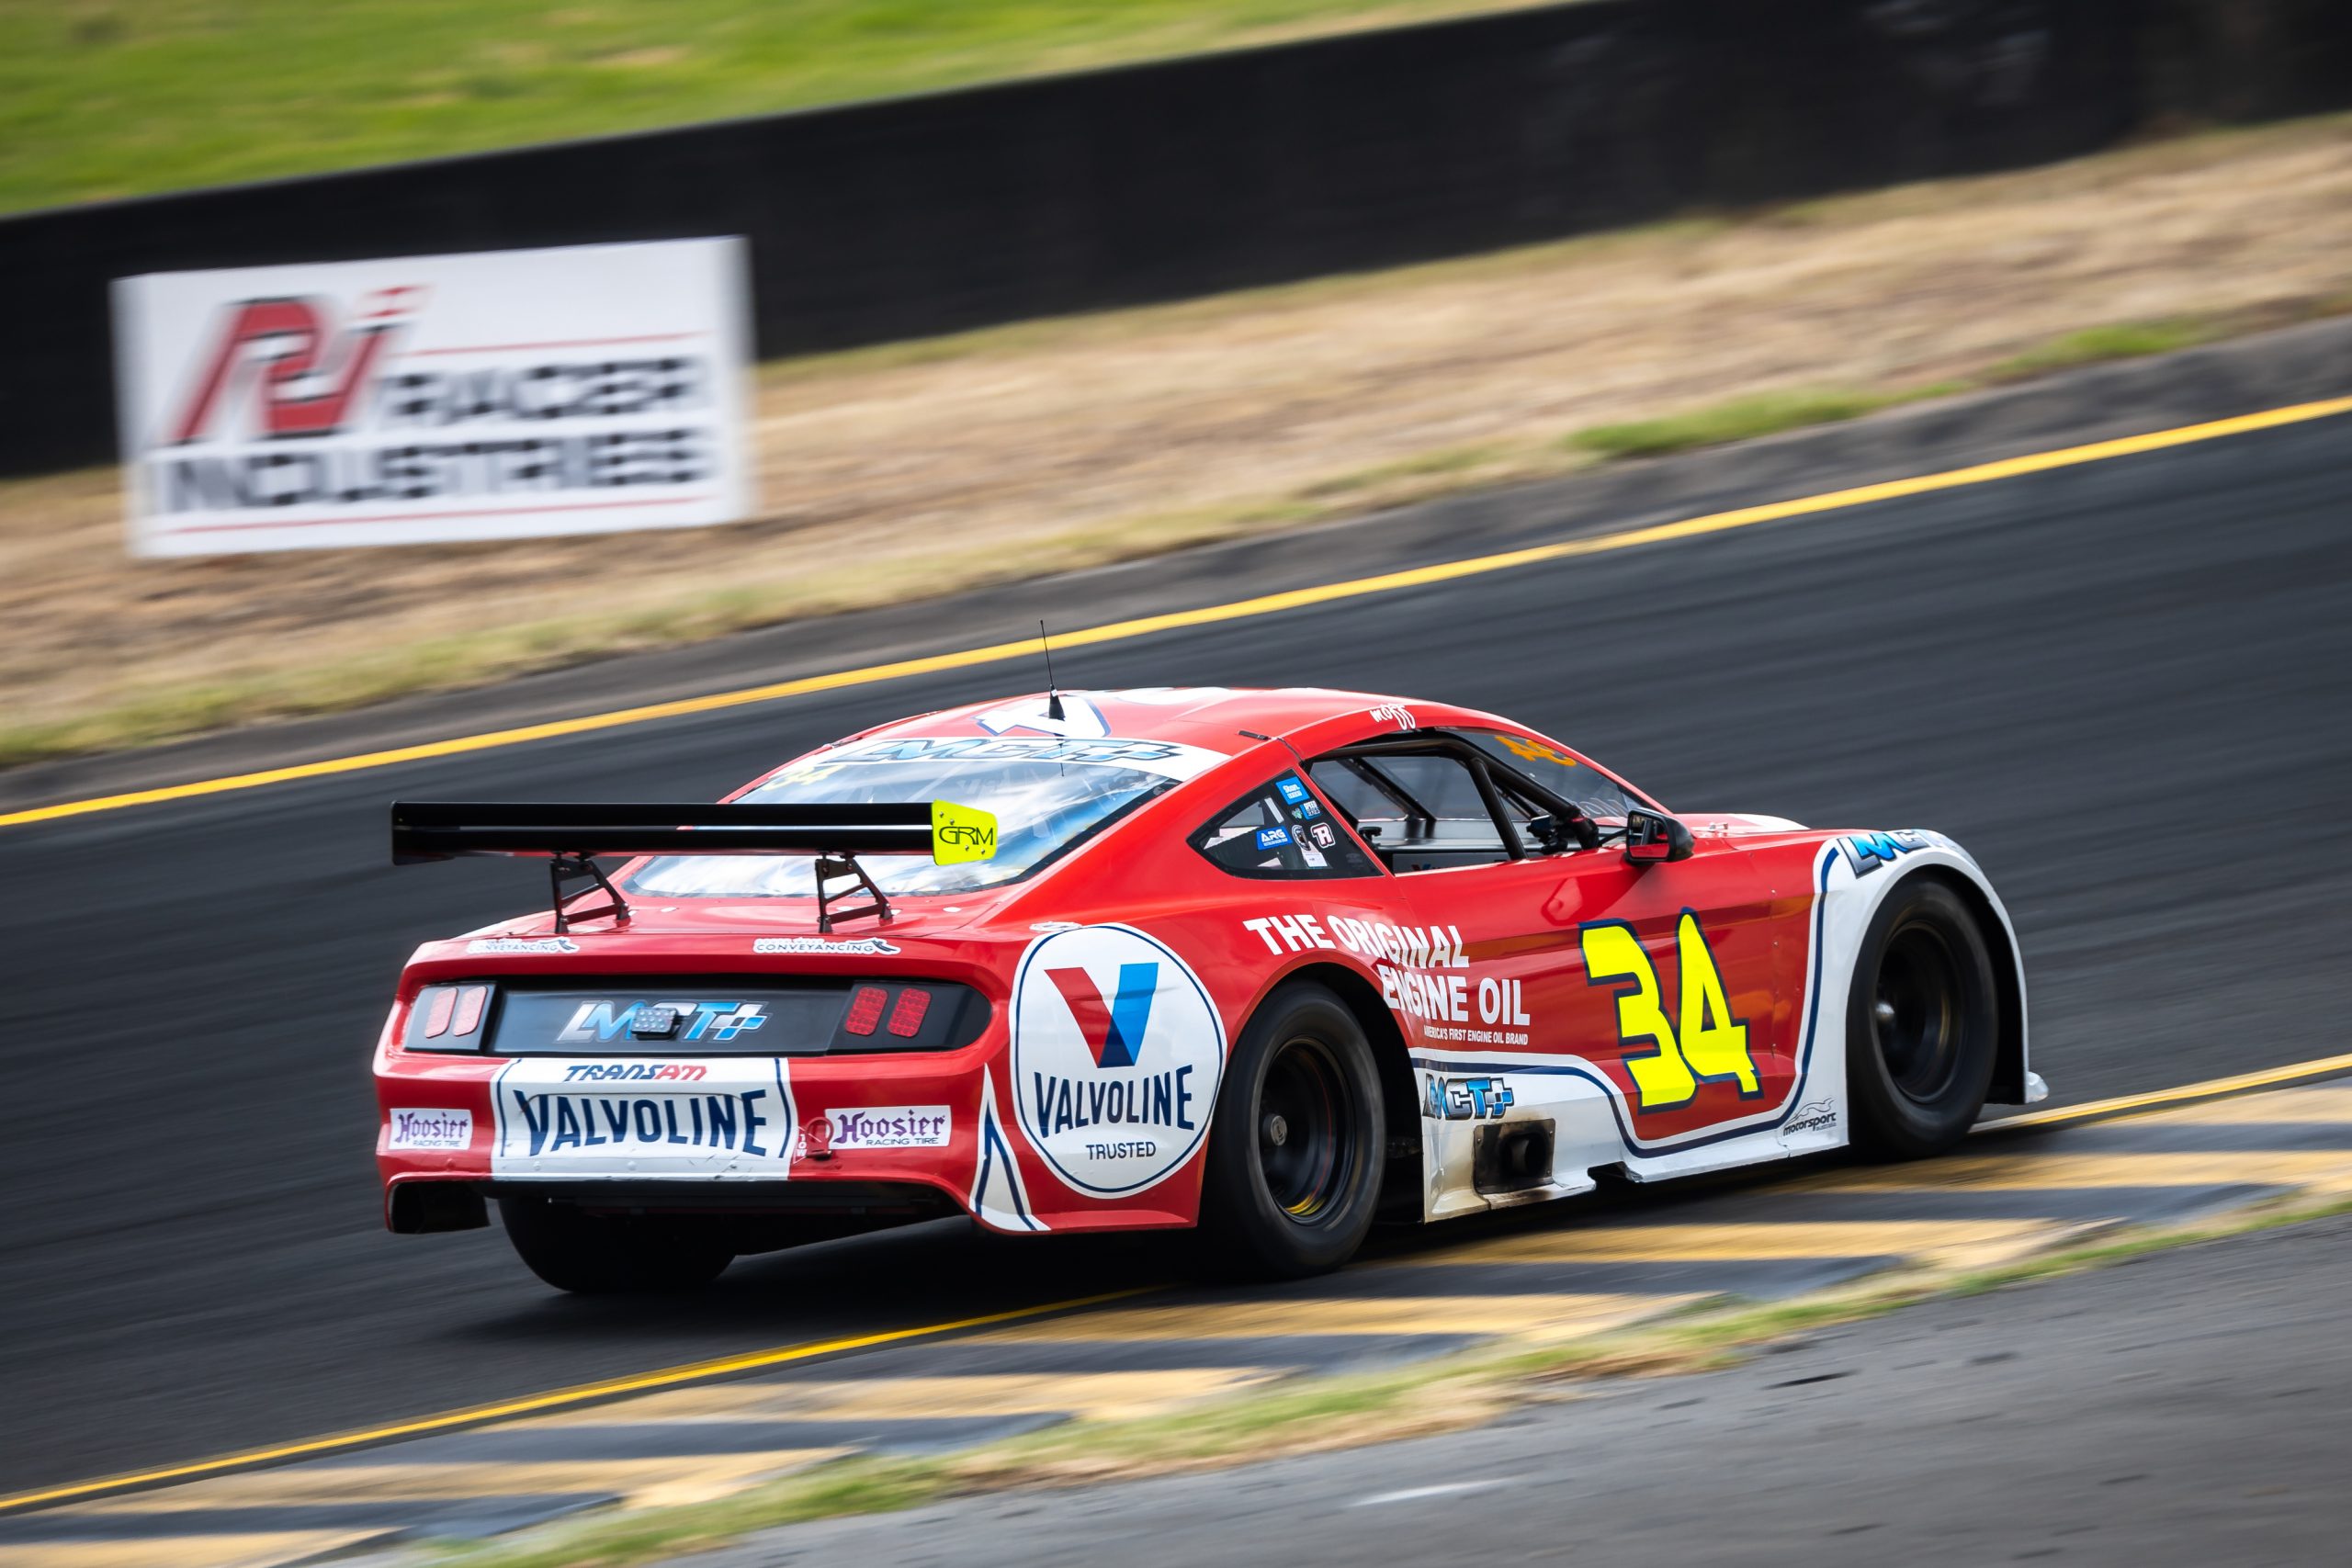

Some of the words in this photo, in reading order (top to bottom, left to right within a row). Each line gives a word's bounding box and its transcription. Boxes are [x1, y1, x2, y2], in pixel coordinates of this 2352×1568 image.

[939, 826, 994, 846] GRM
[1261, 829, 1287, 842] ARG
[756, 942, 875, 953] CONVEYANCING
[1242, 913, 1338, 956] THE
[1325, 913, 1471, 970] ORIGINAL
[1374, 963, 1470, 1023] ENGINE
[1476, 976, 1532, 1027] OIL
[1577, 905, 1764, 1114] 34
[1448, 1027, 1467, 1042] FIRST
[1467, 1029, 1492, 1043] ENGINE
[1492, 1032, 1505, 1044] OIL
[1504, 1032, 1529, 1046] BRAND
[1034, 1064, 1194, 1139] VALVOLINE
[395, 1111, 468, 1143] Hoosier
[513, 1089, 767, 1157] VALVOLINE
[833, 1110, 945, 1144] Hoosier
[1783, 1112, 1837, 1136] motorsport
[1085, 1141, 1157, 1161] TRUSTED
